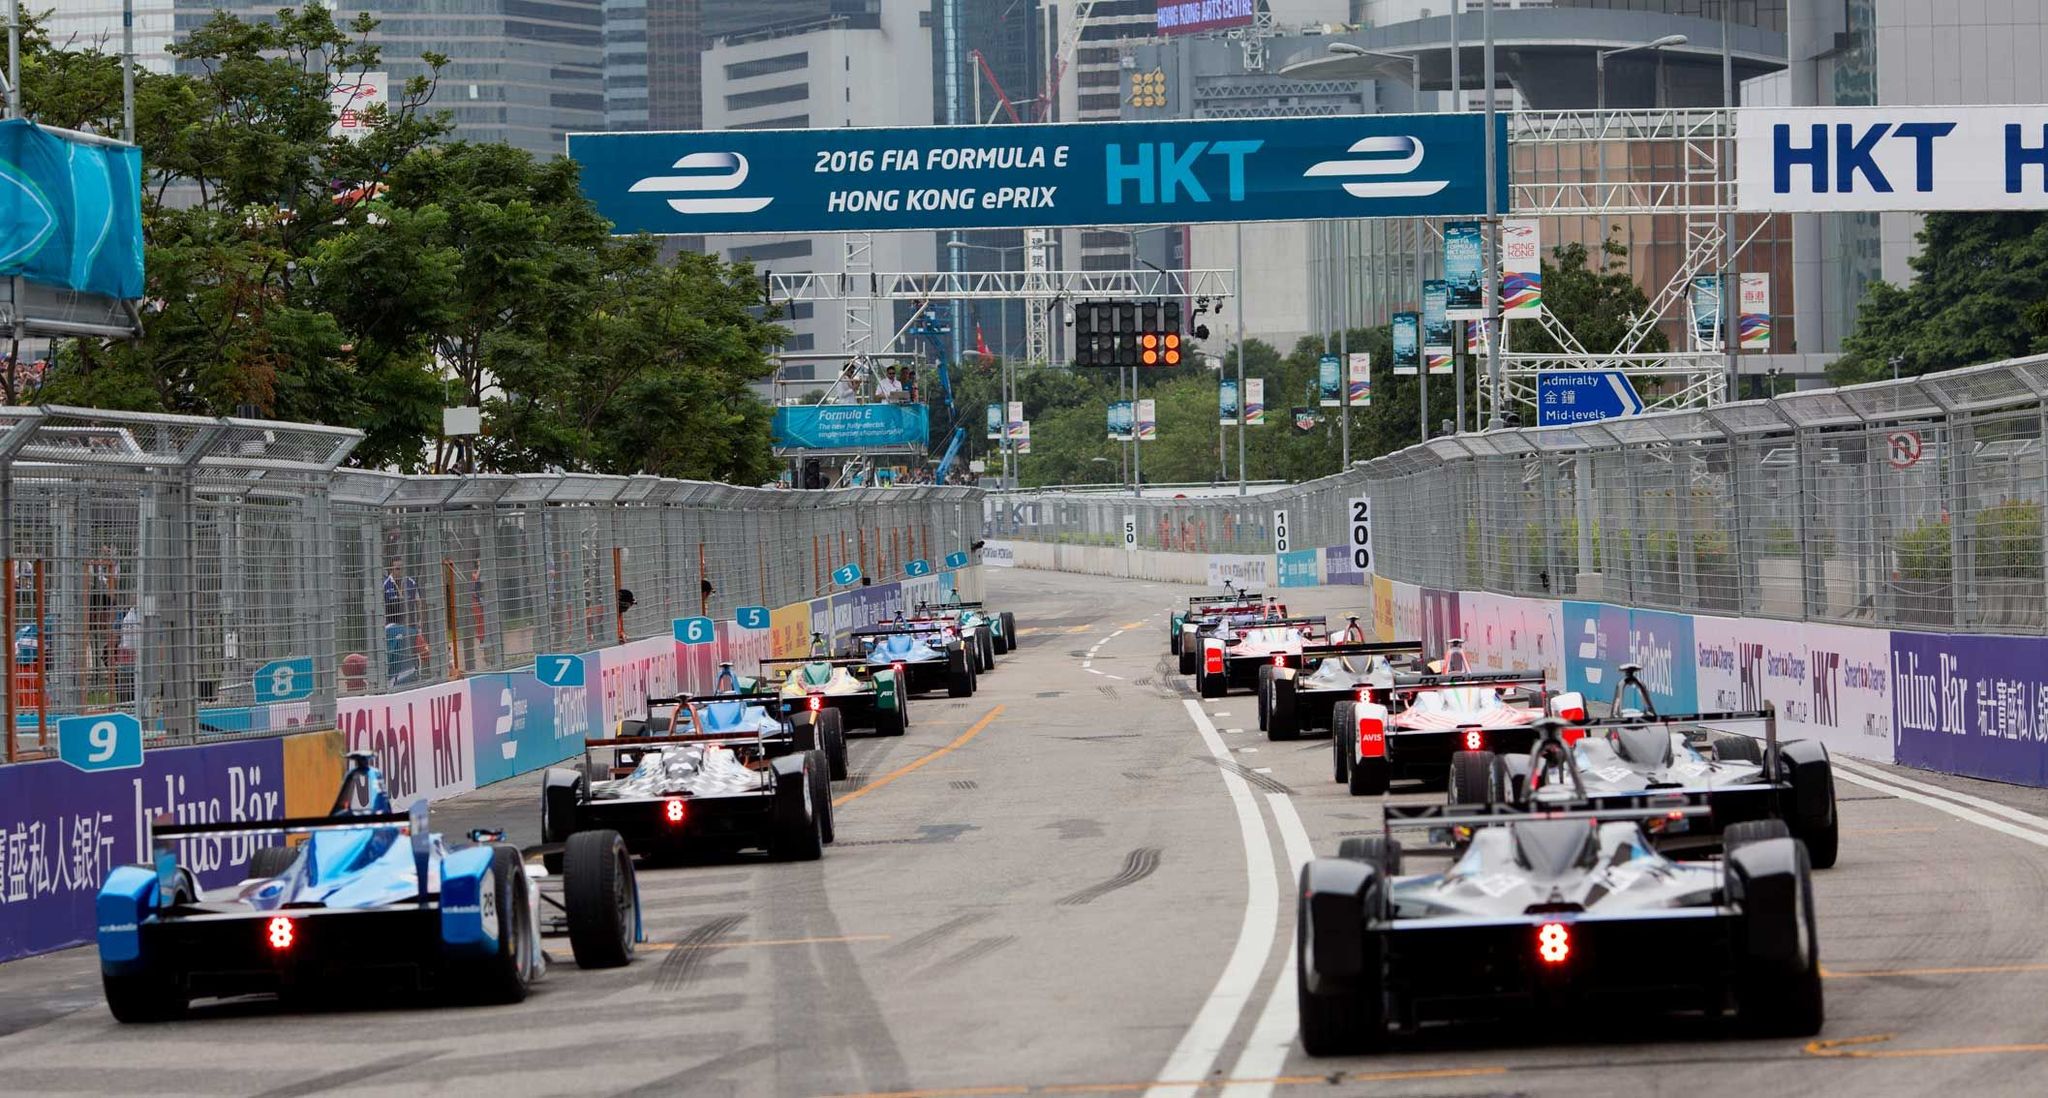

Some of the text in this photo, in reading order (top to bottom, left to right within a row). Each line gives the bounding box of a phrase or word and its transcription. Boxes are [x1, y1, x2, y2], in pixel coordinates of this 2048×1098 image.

[1158, 6, 1178, 27] HONG
[1179, 3, 1200, 24] KONG
[1202, 0, 1222, 21] ARTS
[814, 146, 1069, 173] 2016 FIA FORMULA E
[1773, 122, 1958, 193] HKT
[1105, 139, 1265, 205] HKT
[828, 185, 1057, 212] HONG KONG ePRIX
[1507, 242, 1535, 250] HONG
[1507, 249, 1535, 257] KONG
[1543, 375, 1599, 387] Admiralty
[1544, 390, 1576, 404] 金鐘
[818, 408, 873, 421] Formula E
[1546, 409, 1606, 421] Mid-levels
[1126, 522, 1135, 544] 50
[1277, 512, 1287, 551] 100
[1353, 501, 1370, 569] 200
[914, 562, 922, 574] 2
[953, 554, 960, 564] 1
[842, 568, 853, 582] 3
[688, 620, 702, 641] 6
[748, 609, 760, 626] 5
[272, 666, 294, 696] 8
[553, 658, 572, 682] 7
[1739, 643, 1763, 712] HKT
[1812, 650, 1840, 728] HKT
[1895, 650, 1968, 746] Julius Bär
[88, 721, 118, 762] 9
[430, 692, 462, 789] HKT
[1362, 733, 1382, 742] AVIS
[228, 766, 279, 867] Bär
[0, 811, 115, 904] 盛私人銀行
